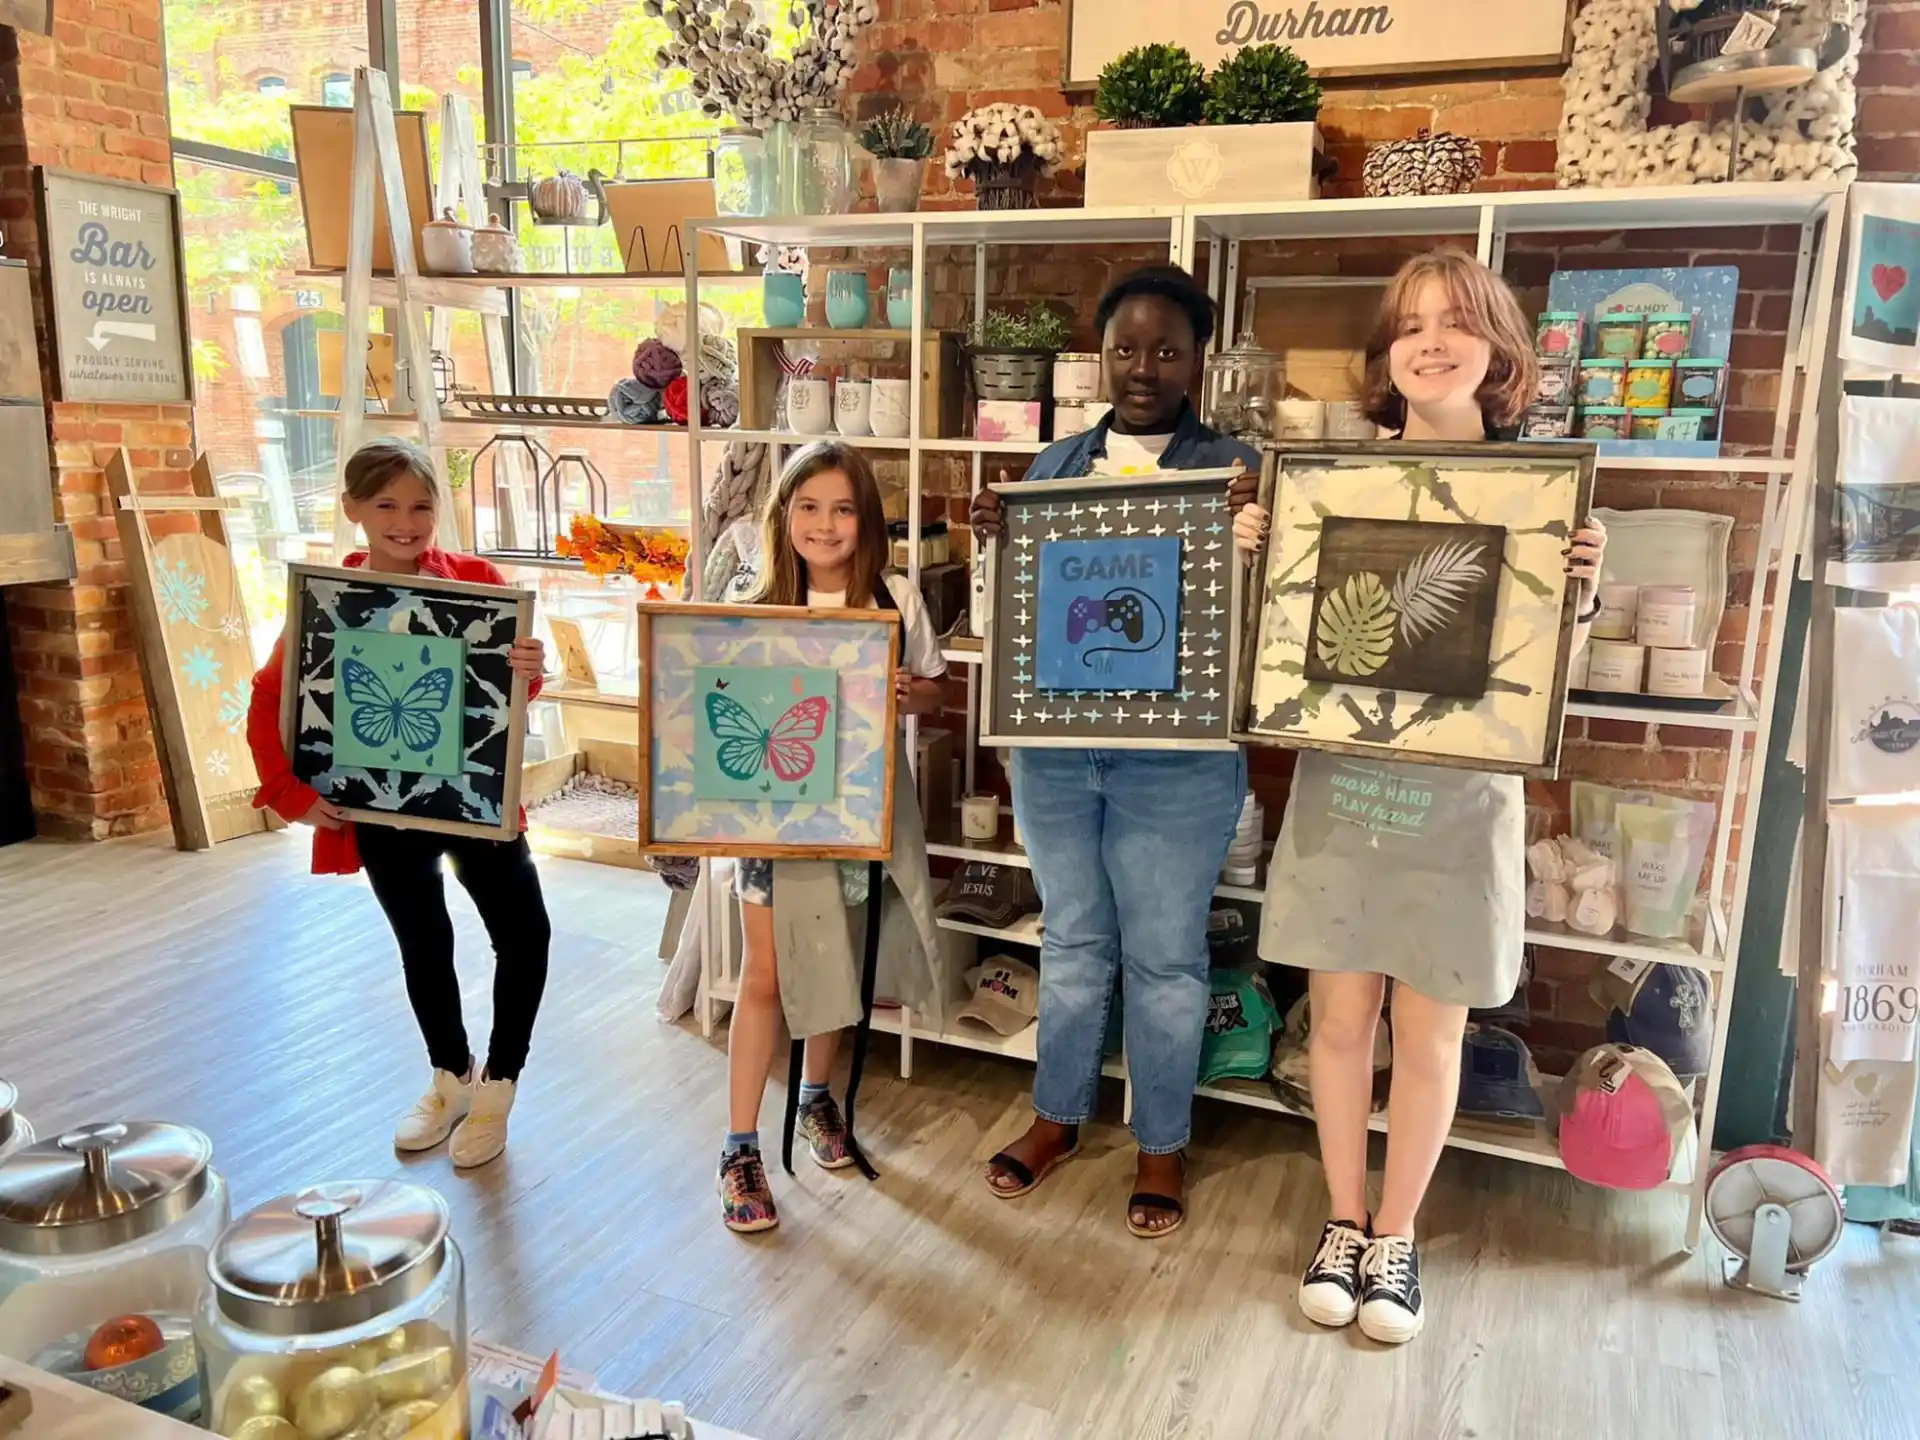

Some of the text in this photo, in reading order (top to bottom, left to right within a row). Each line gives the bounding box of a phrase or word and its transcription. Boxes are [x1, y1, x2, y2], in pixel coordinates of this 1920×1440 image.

[1215, 0, 1394, 45] Durham
[78, 201, 142, 222] THE WRIGHT
[70, 221, 155, 270] Bar
[85, 271, 146, 289] IS ALWAYS
[82, 289, 153, 317] open
[1625, 303, 1669, 313] CANDY
[75, 354, 164, 369] PROUDLY SERVING
[1060, 554, 1154, 582] GAME
[1093, 658, 1115, 675] ON
[1331, 773, 1433, 807] work HARD
[1332, 793, 1426, 827] PLAY hard
[964, 863, 998, 878] LVE
[1641, 860, 1666, 873] WAKE
[1637, 871, 1667, 884] ME UP
[960, 882, 995, 897] JESUS
[1841, 984, 1919, 1024] 1869
